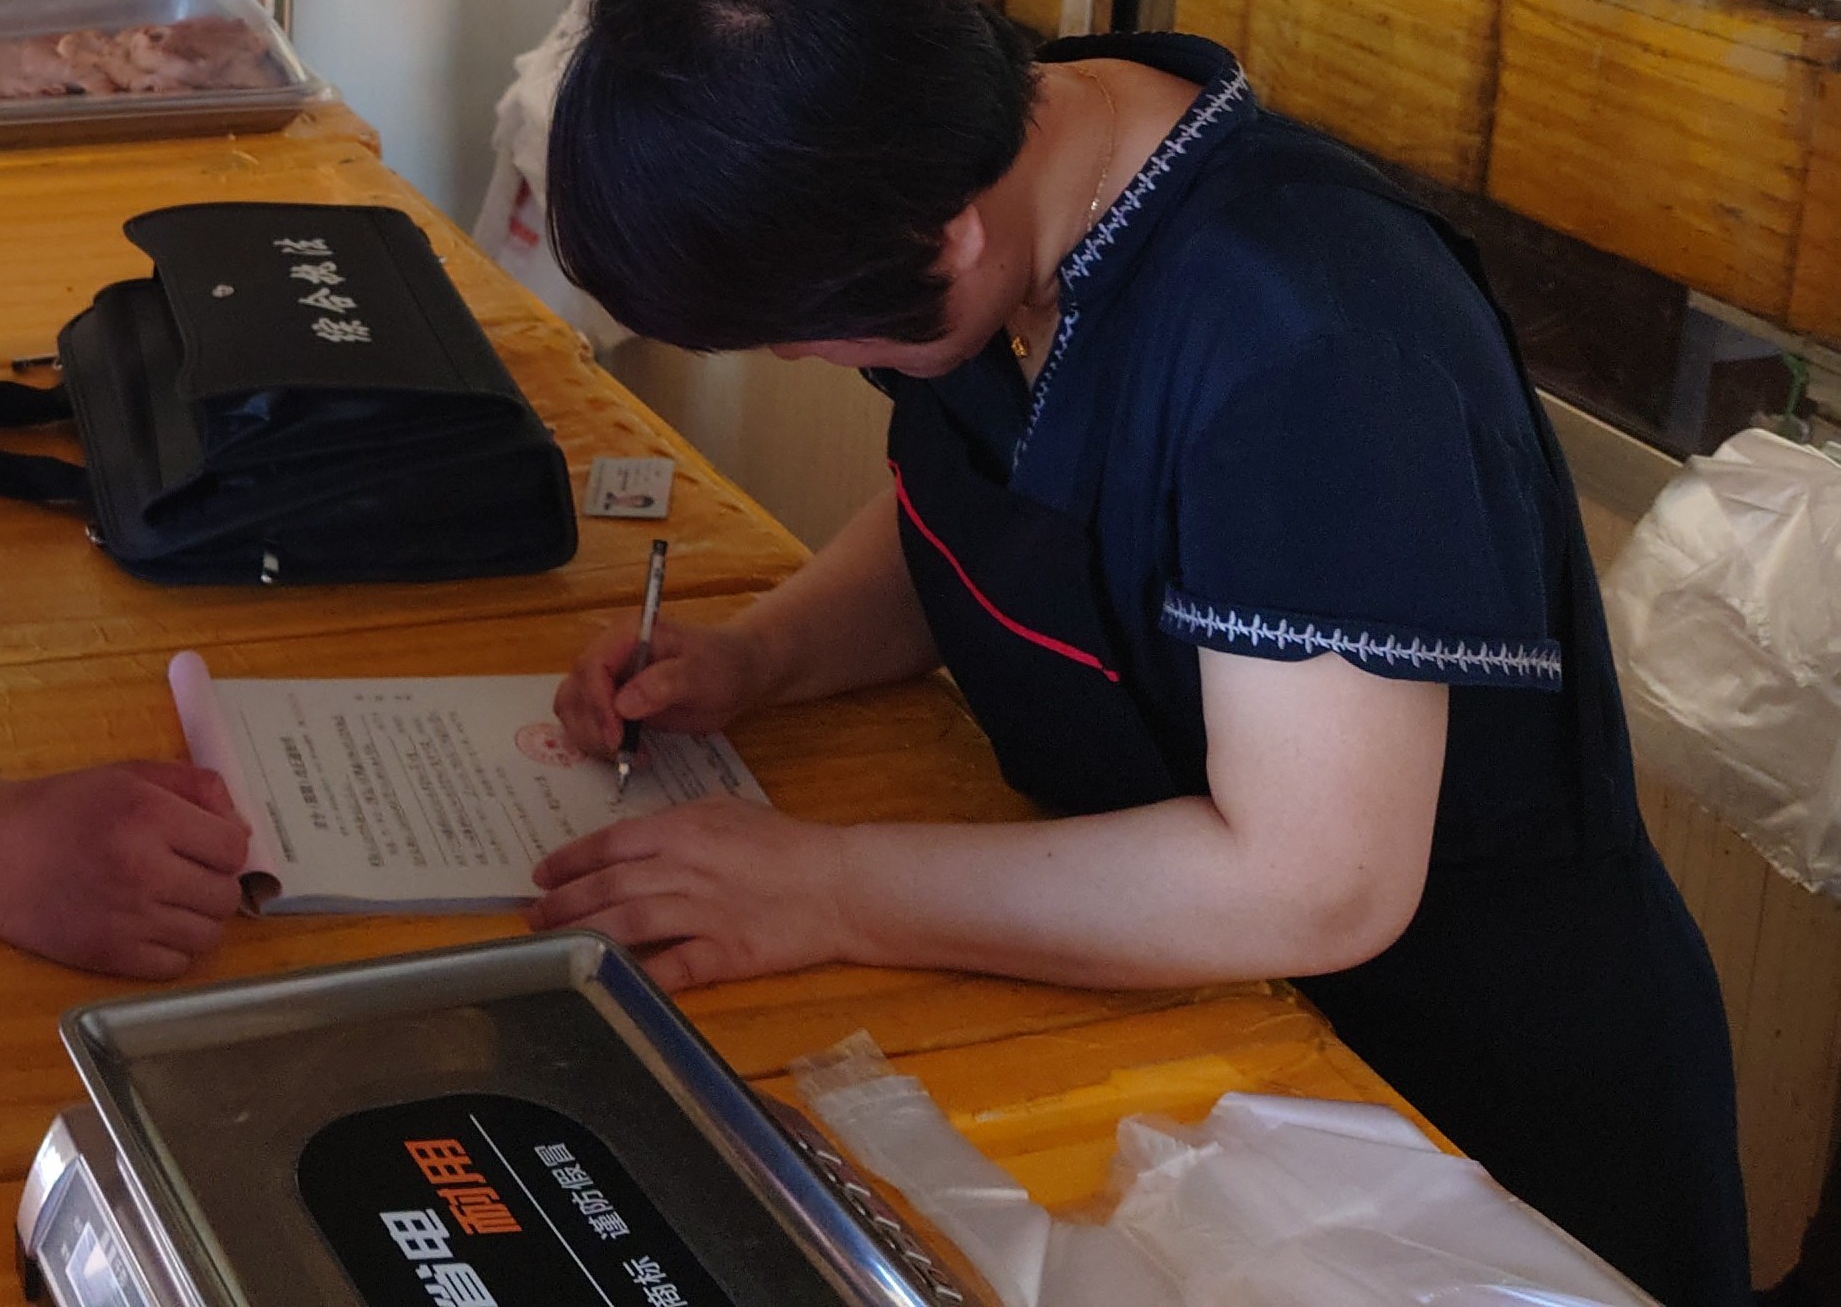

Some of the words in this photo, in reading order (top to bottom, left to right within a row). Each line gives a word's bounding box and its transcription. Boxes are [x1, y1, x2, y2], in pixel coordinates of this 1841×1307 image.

[272, 237, 372, 343] 综合执法
[403, 1138, 523, 1235] 耐用
[534, 1142, 630, 1240] 谨防假冒
